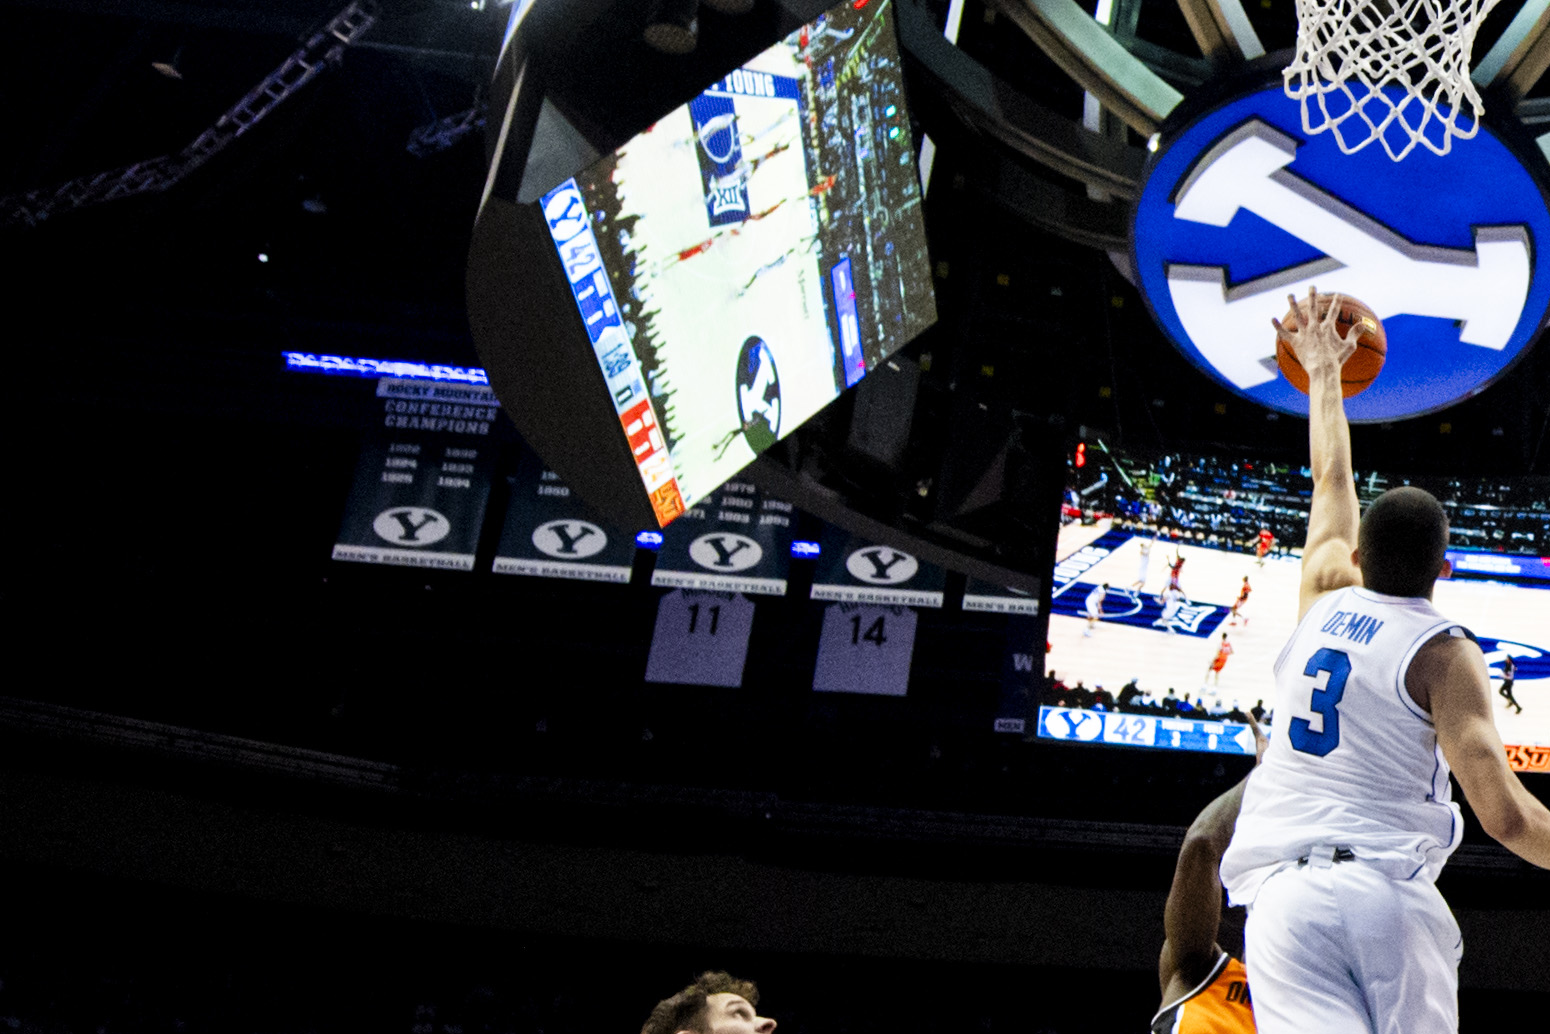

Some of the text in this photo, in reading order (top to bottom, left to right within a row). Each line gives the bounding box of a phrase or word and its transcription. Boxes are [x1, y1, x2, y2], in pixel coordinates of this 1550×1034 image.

[550, 195, 583, 230] Y
[566, 243, 595, 275] 42
[385, 399, 498, 421] CONFERENCE
[433, 387, 499, 402] MOUNTAI
[385, 413, 490, 435] CHAMPIONS
[688, 604, 720, 636] 11
[851, 614, 888, 647] 14
[1321, 610, 1385, 646] DEMIN
[1288, 647, 1352, 758] 3
[1057, 709, 1092, 739] Y
[1112, 717, 1147, 742] 42
